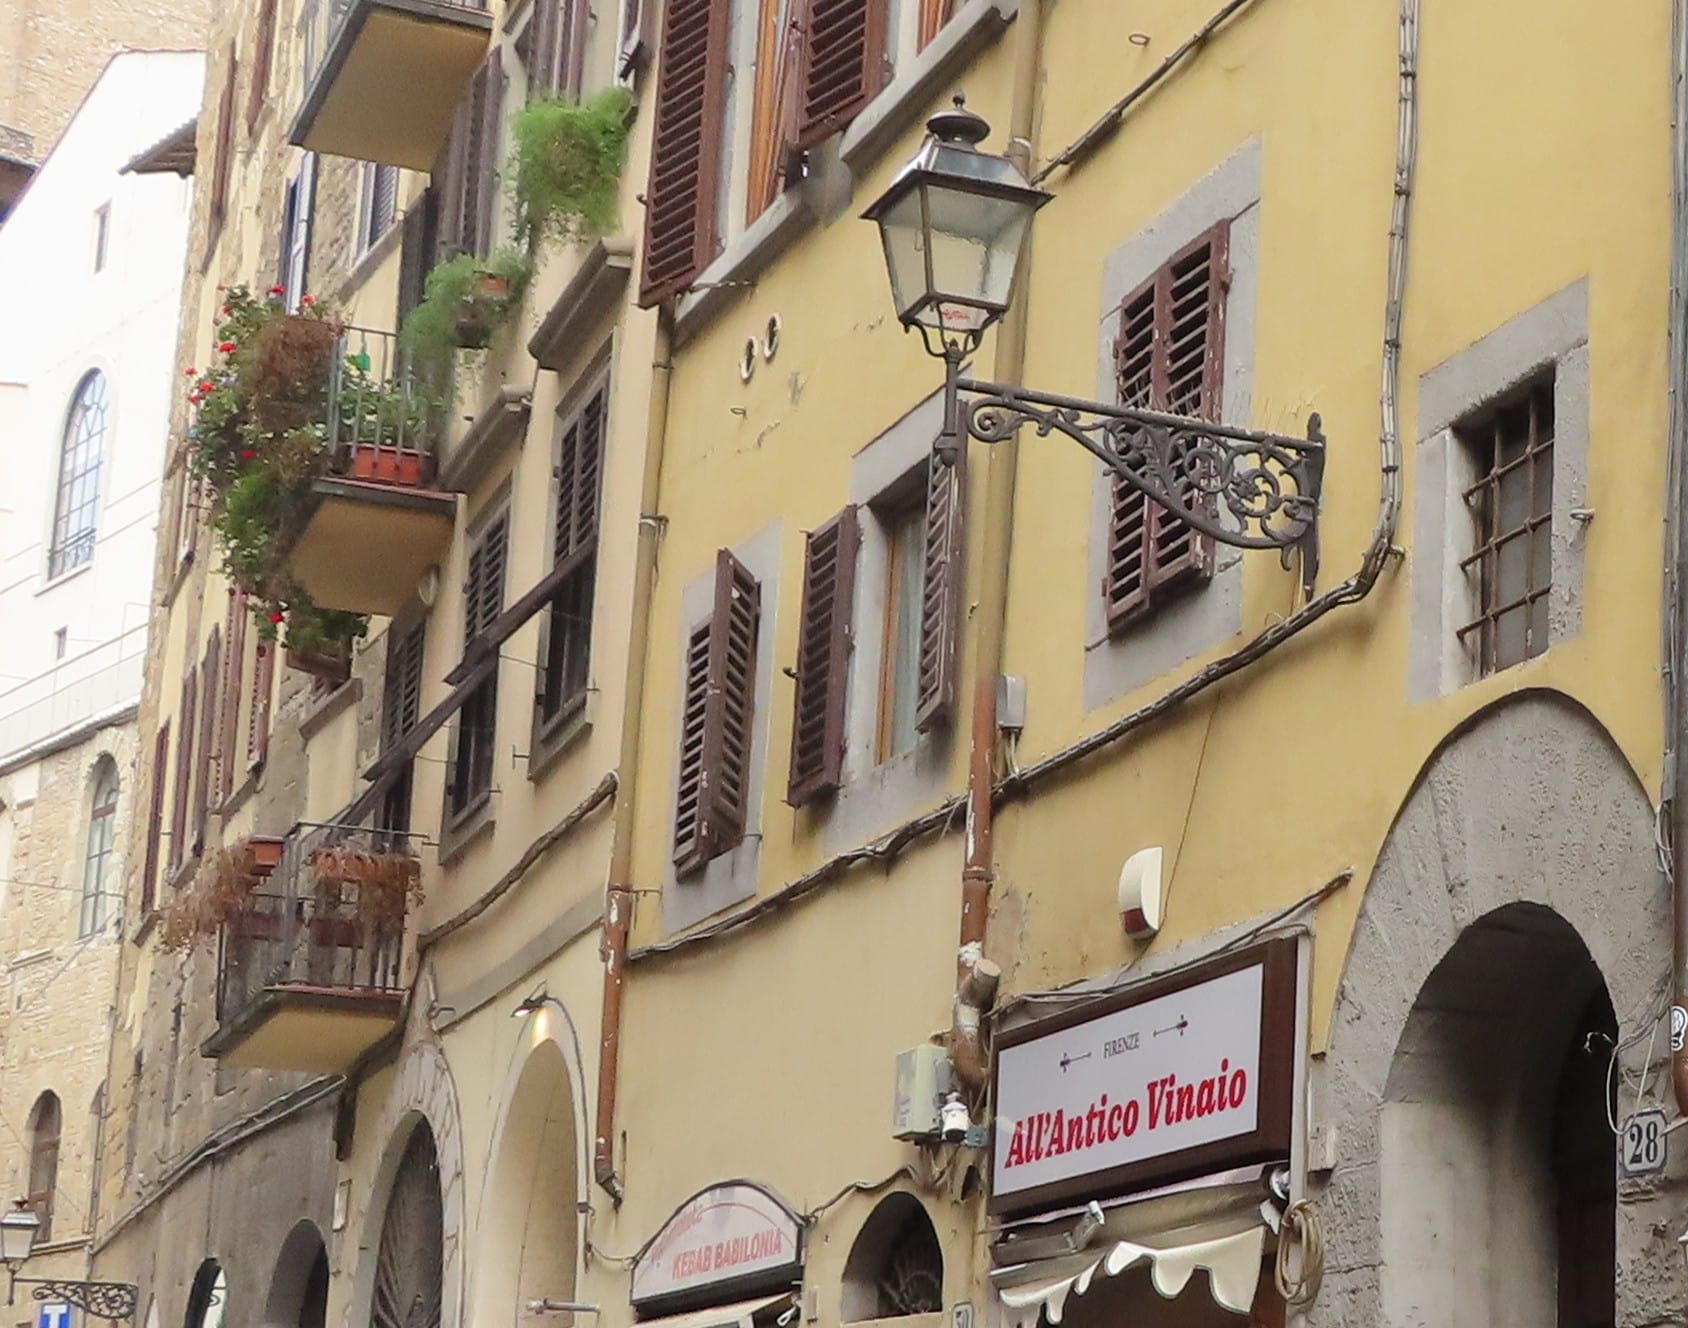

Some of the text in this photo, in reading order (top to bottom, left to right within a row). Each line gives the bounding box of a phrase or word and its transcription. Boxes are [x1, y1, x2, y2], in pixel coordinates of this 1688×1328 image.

[1103, 1032, 1141, 1058] FIRENZE
[1004, 1058, 1248, 1169] All'Antico Vinaio
[1628, 1121, 1658, 1166] 28
[672, 1245, 714, 1280] KEBAB
